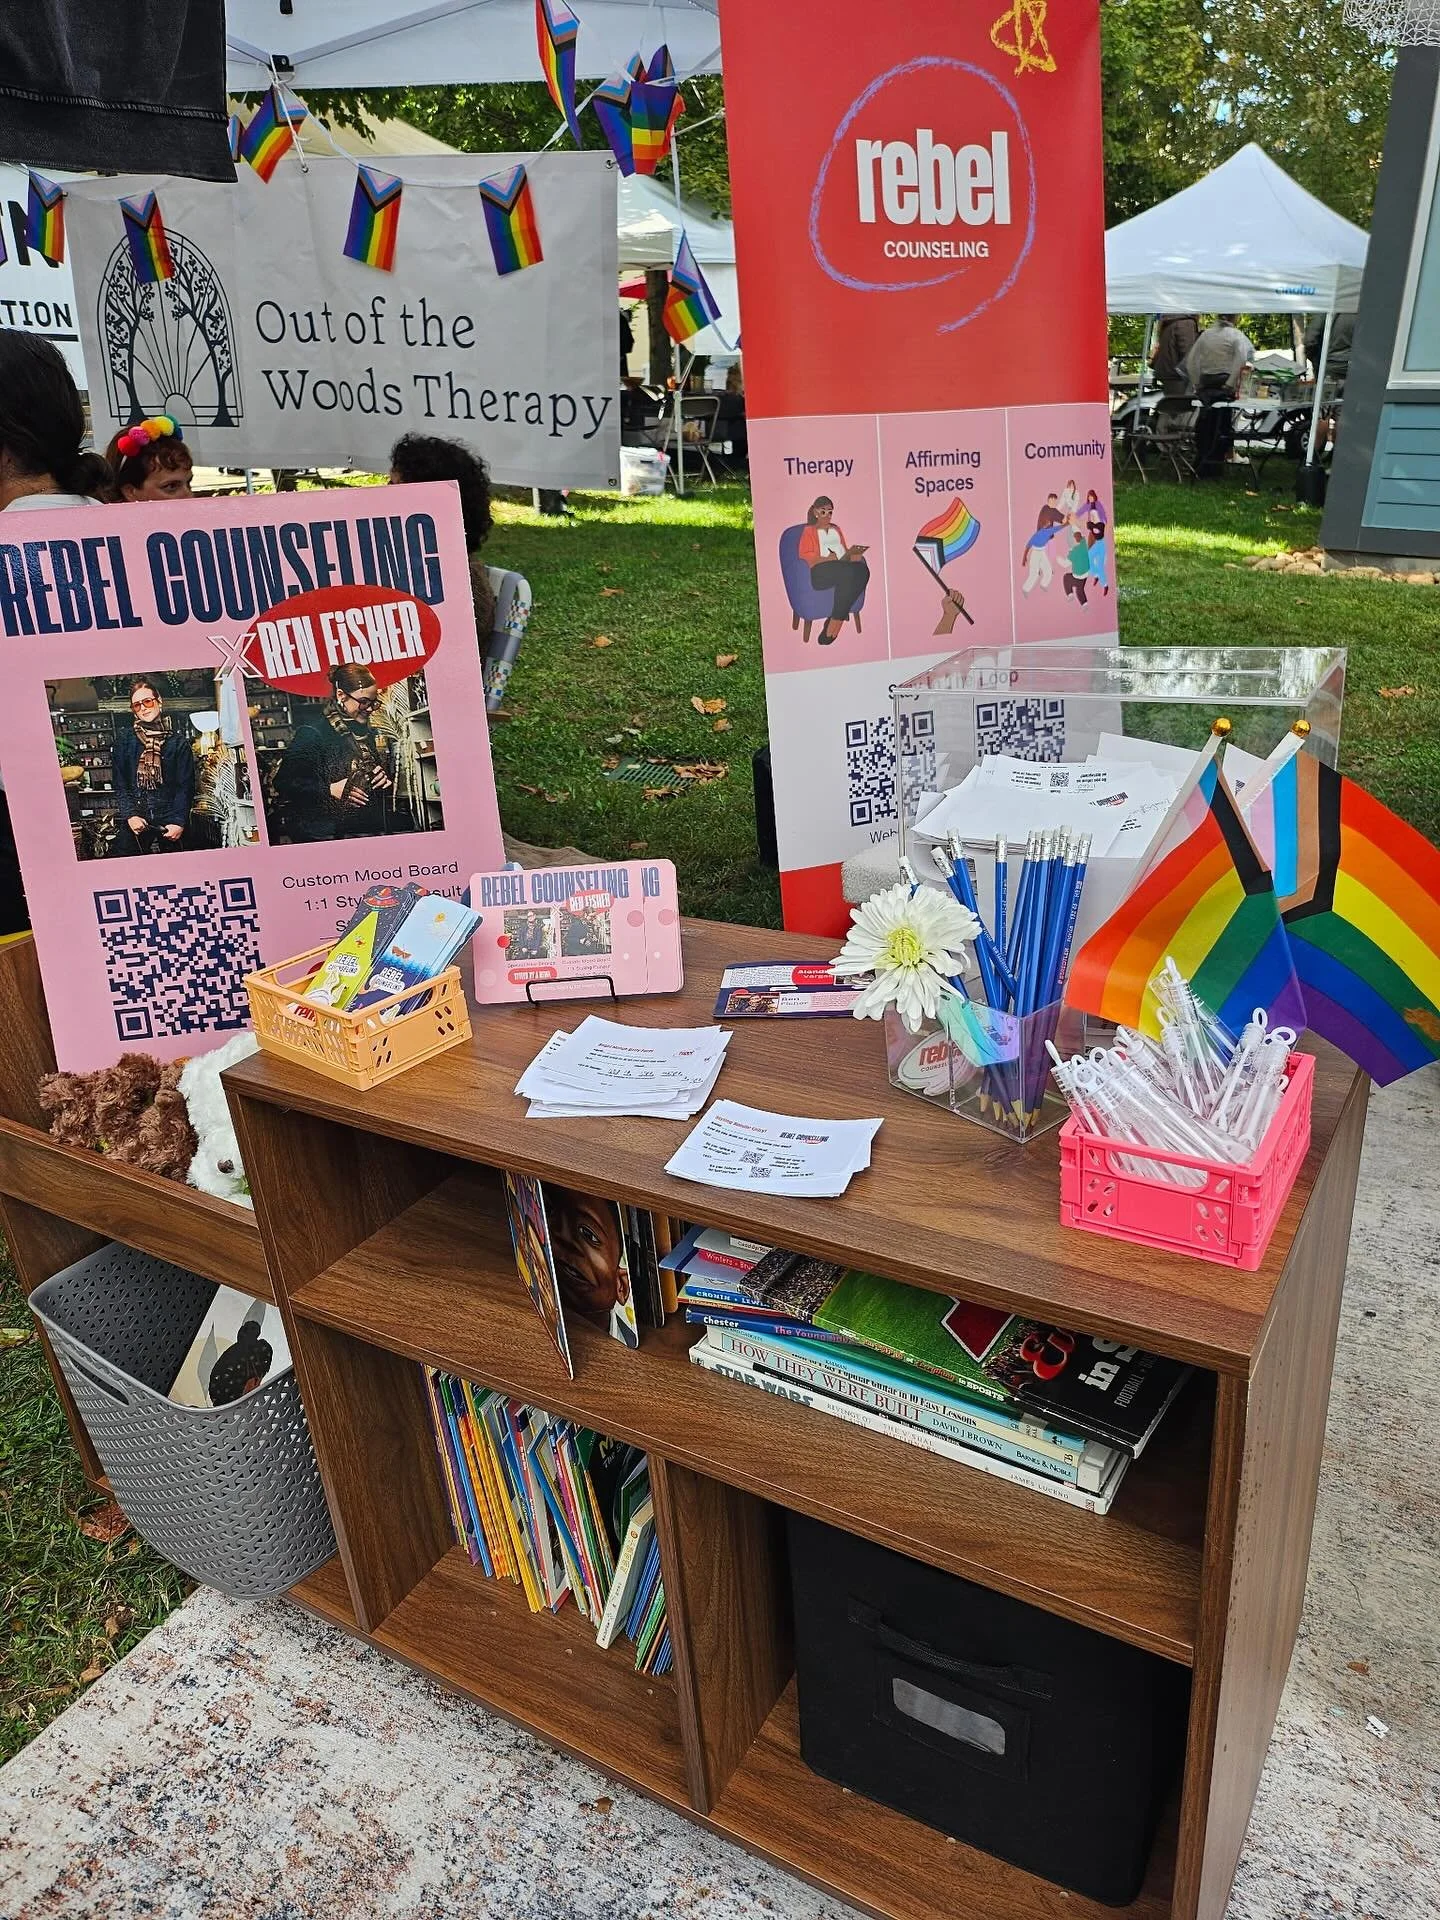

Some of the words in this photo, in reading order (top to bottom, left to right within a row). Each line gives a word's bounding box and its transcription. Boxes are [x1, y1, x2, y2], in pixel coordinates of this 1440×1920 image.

[855, 129, 1011, 225] rebel
[883, 240, 989, 260] COUNSELING
[0, 300, 73, 328] TION
[256, 300, 337, 344] Out
[346, 296, 386, 345] of
[402, 297, 476, 350] the
[263, 368, 402, 417] Woods
[413, 373, 613, 440] Therapy
[905, 447, 982, 471] Affirming
[1024, 440, 1107, 461] Community
[784, 454, 855, 478] Therapy
[913, 474, 975, 495] Spaces
[0, 535, 143, 637] REBEL
[146, 513, 445, 625] COUNSELING
[258, 616, 326, 681] REN
[282, 872, 349, 889] Custom
[355, 867, 402, 882] Mood
[408, 861, 459, 877] Board
[480, 874, 528, 907] REBEL
[531, 867, 630, 902] COUNSELING
[305, 898, 328, 911] 1:1
[334, 953, 359, 966] REBEL
[379, 967, 405, 982] REBEL
[696, 1291, 731, 1301] CRONIN
[703, 1315, 740, 1327] Chester
[774, 1325, 793, 1336] The
[731, 1336, 769, 1363] HOW
[774, 1353, 818, 1382] THEY
[822, 1373, 870, 1403] WERE
[874, 1390, 924, 1423] BUILT
[931, 1417, 960, 1434] DAVID
[966, 1432, 1003, 1452] BROWN
[965, 1381, 1005, 1402] SPORTS
[1114, 1374, 1146, 1408] FOOTBALL
[713, 1363, 762, 1389] STAR
[761, 1379, 814, 1408] WARS
[1010, 1473, 1035, 1488] JAMES
[1037, 1484, 1070, 1499] LUCENO
